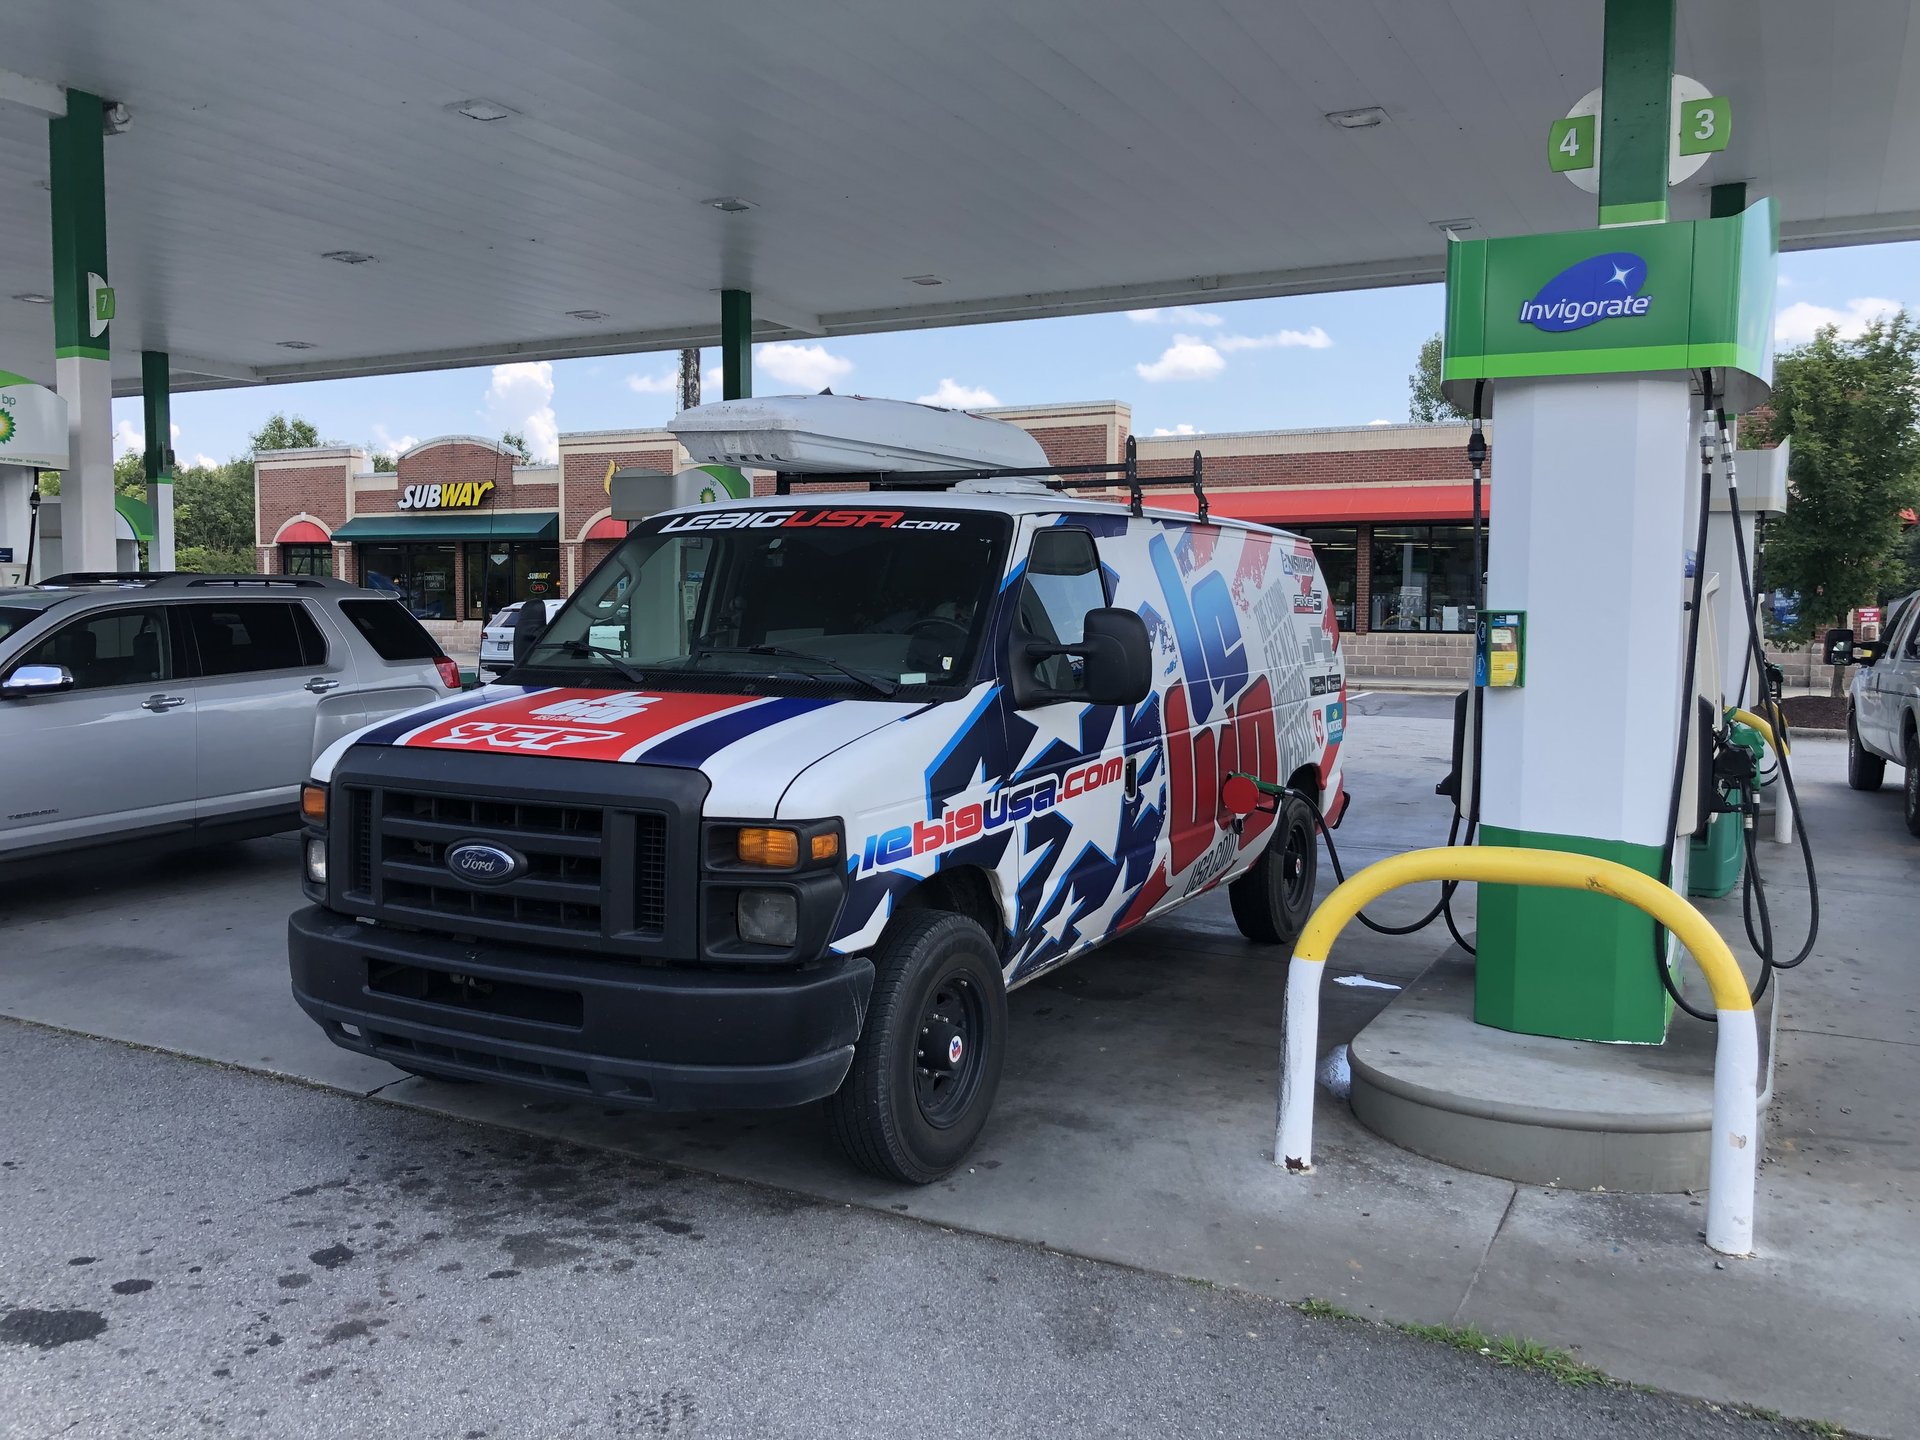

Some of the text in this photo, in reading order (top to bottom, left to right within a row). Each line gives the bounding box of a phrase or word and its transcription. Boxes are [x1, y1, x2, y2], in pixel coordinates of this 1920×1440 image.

[1694, 108, 1715, 140] 3
[1559, 127, 1580, 157] 4
[101, 294, 108, 312] 7
[1520, 296, 1649, 324] Invigorate
[2, 394, 16, 407] bp
[397, 480, 495, 509] SUBWAY
[11, 573, 20, 585] 7
[1263, 615, 1301, 694] FRENCH
[1278, 700, 1315, 787] WEBSITE
[7, 808, 59, 820] TERRAIN
[861, 756, 1124, 872] lebigusa.com
[461, 850, 496, 872] Ford
